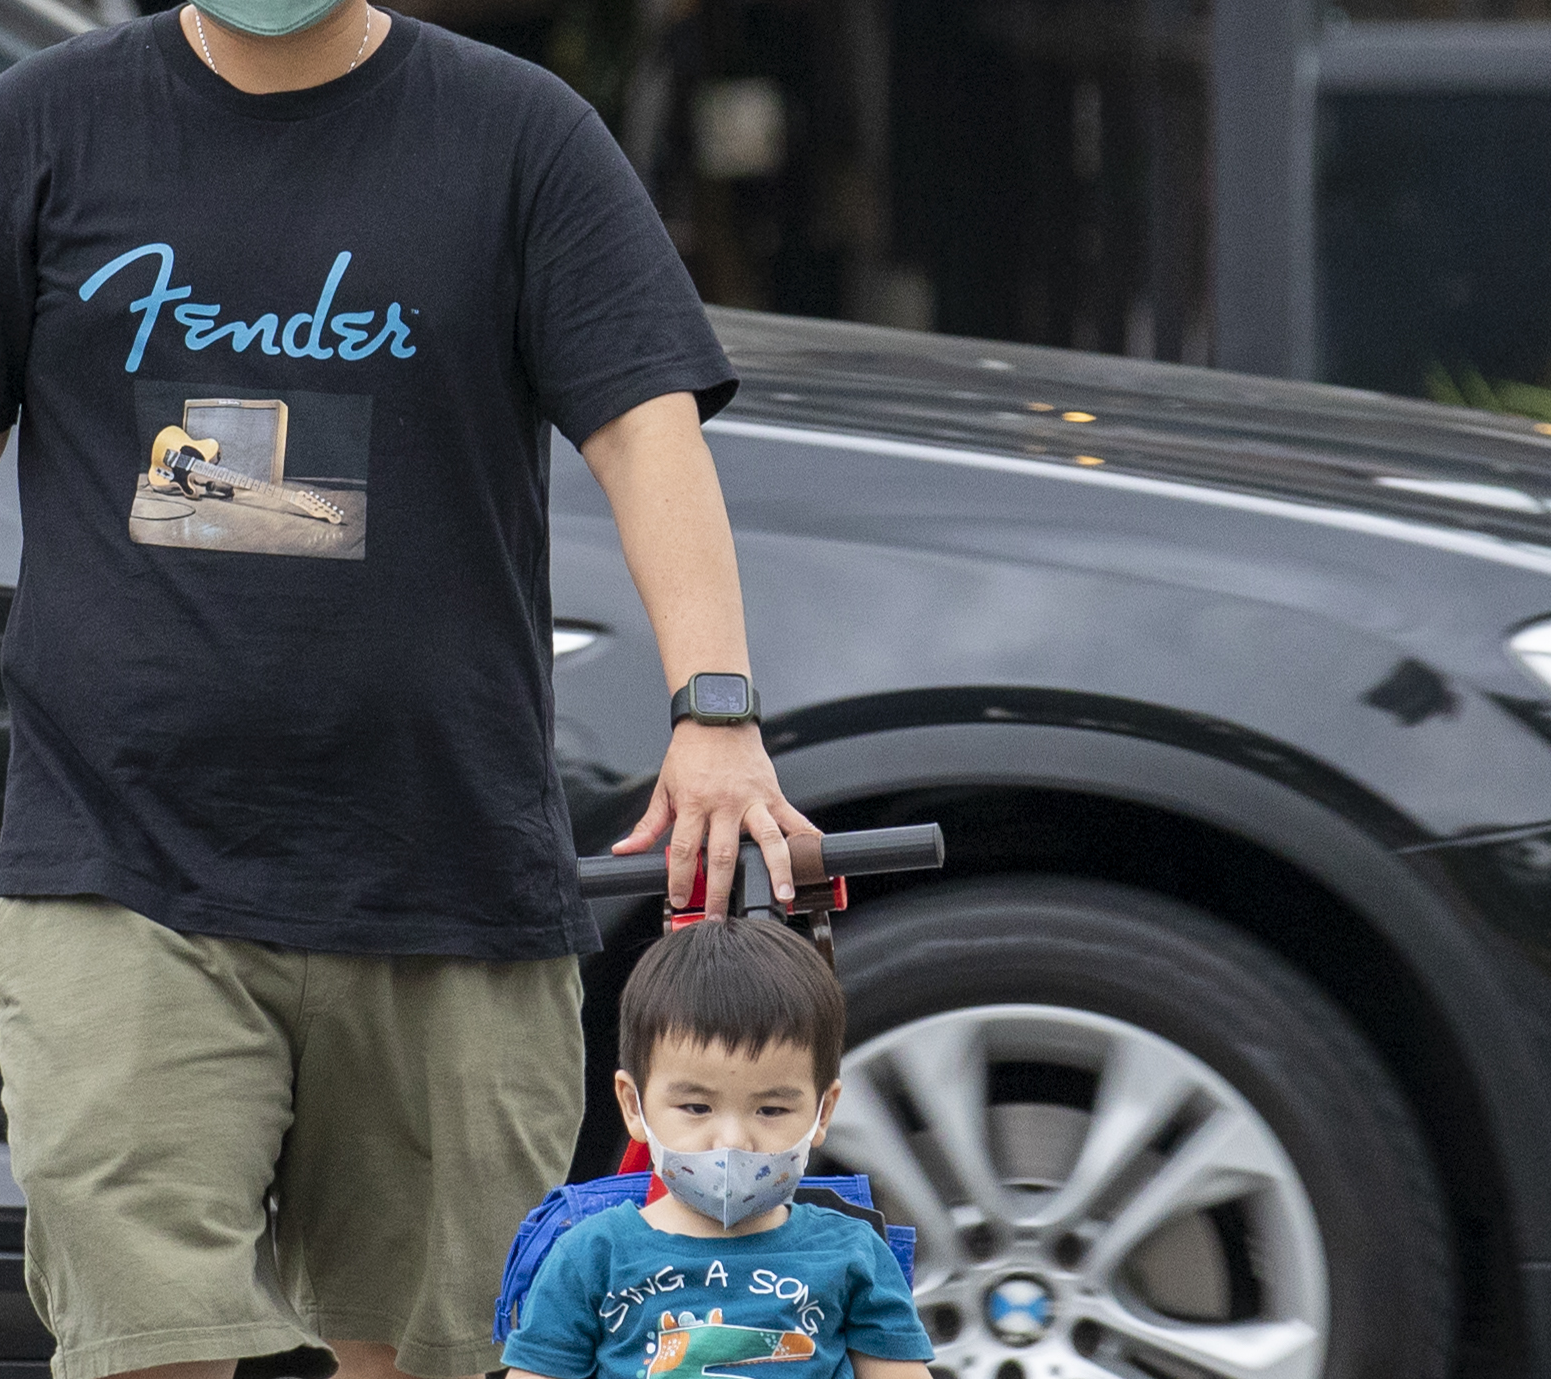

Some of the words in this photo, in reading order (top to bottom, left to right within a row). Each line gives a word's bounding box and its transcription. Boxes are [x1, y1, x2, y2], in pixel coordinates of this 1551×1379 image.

[78, 242, 417, 373] Fender
[598, 1265, 686, 1334] SING
[705, 1259, 729, 1288] A
[749, 1268, 825, 1337] SONG
